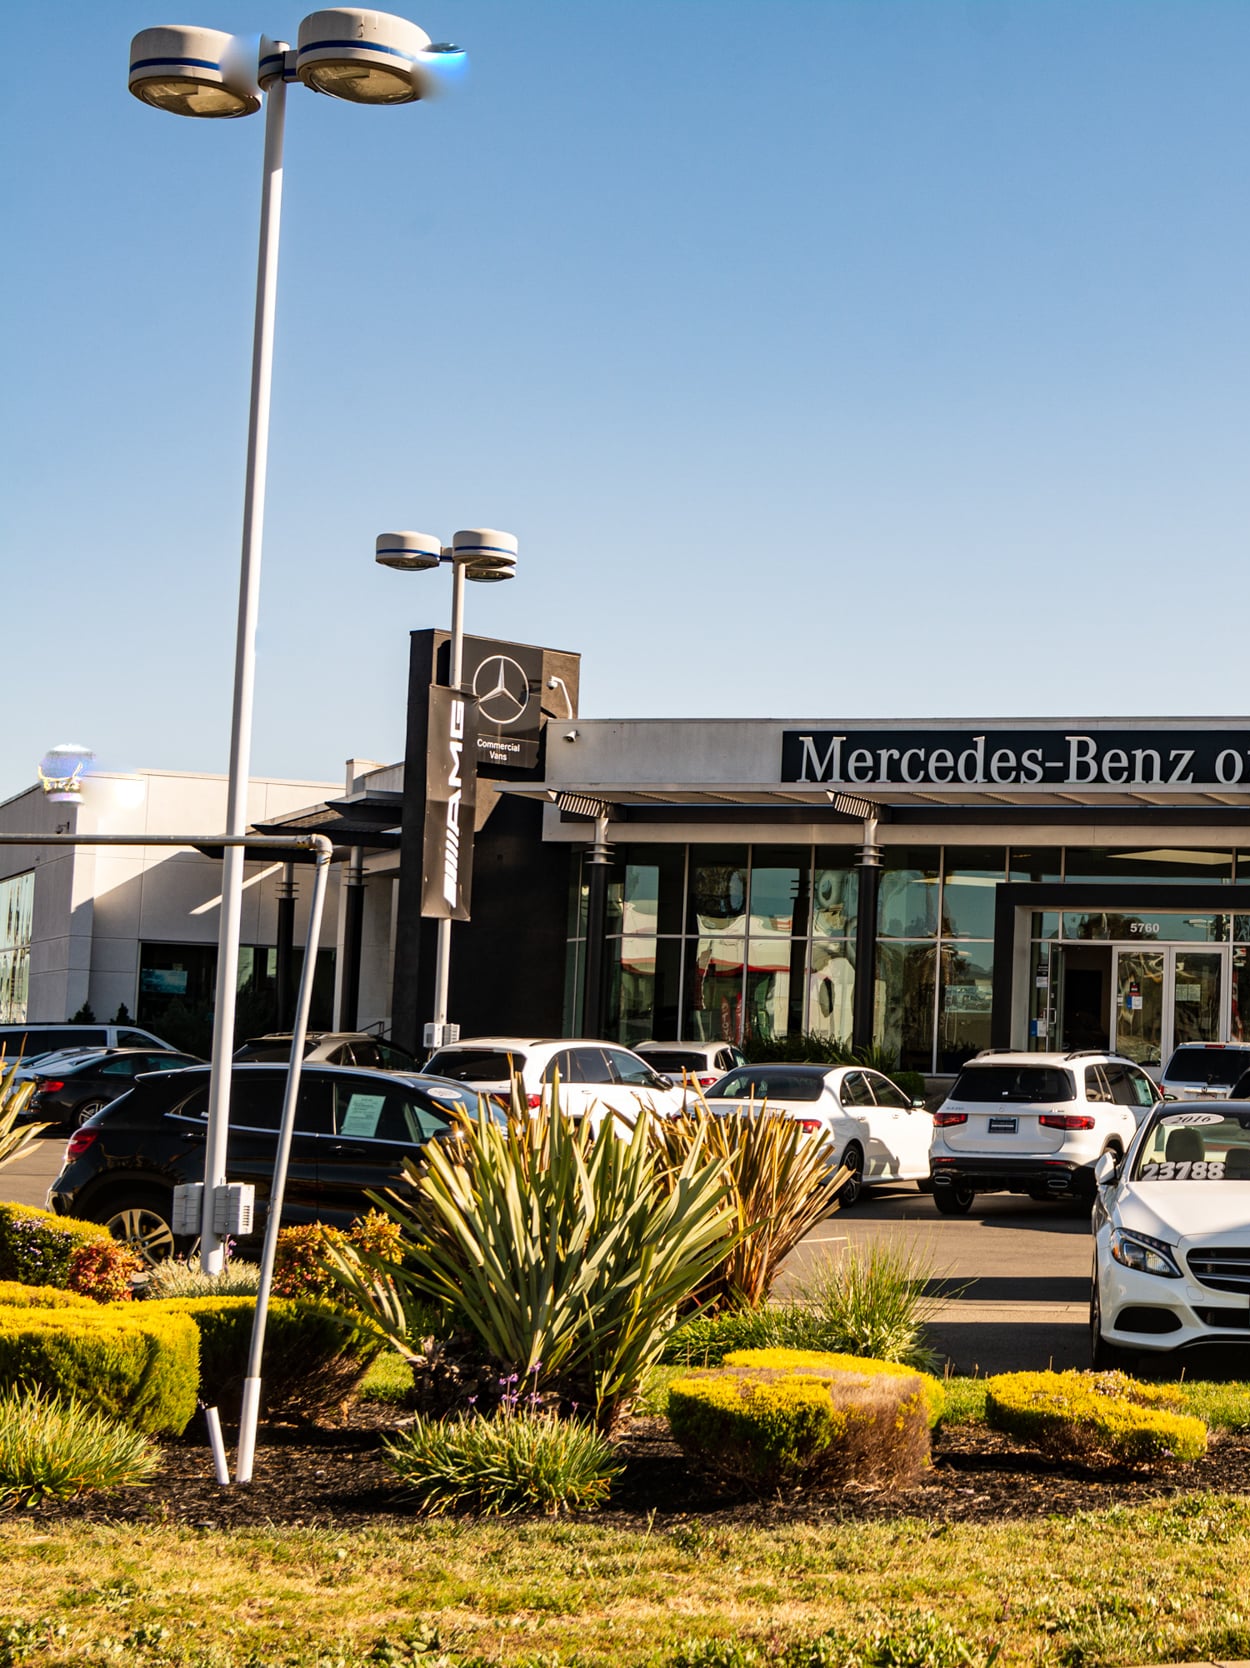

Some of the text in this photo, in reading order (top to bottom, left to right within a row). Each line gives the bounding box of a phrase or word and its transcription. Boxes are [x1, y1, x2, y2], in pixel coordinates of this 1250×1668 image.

[476, 738, 521, 752] Commercial
[489, 750, 508, 761] Vans
[796, 735, 1195, 784] Mercedes-Benz
[1130, 922, 1160, 933] 5760
[1171, 1116, 1211, 1124] 2016
[1143, 1161, 1225, 1180] 23788
